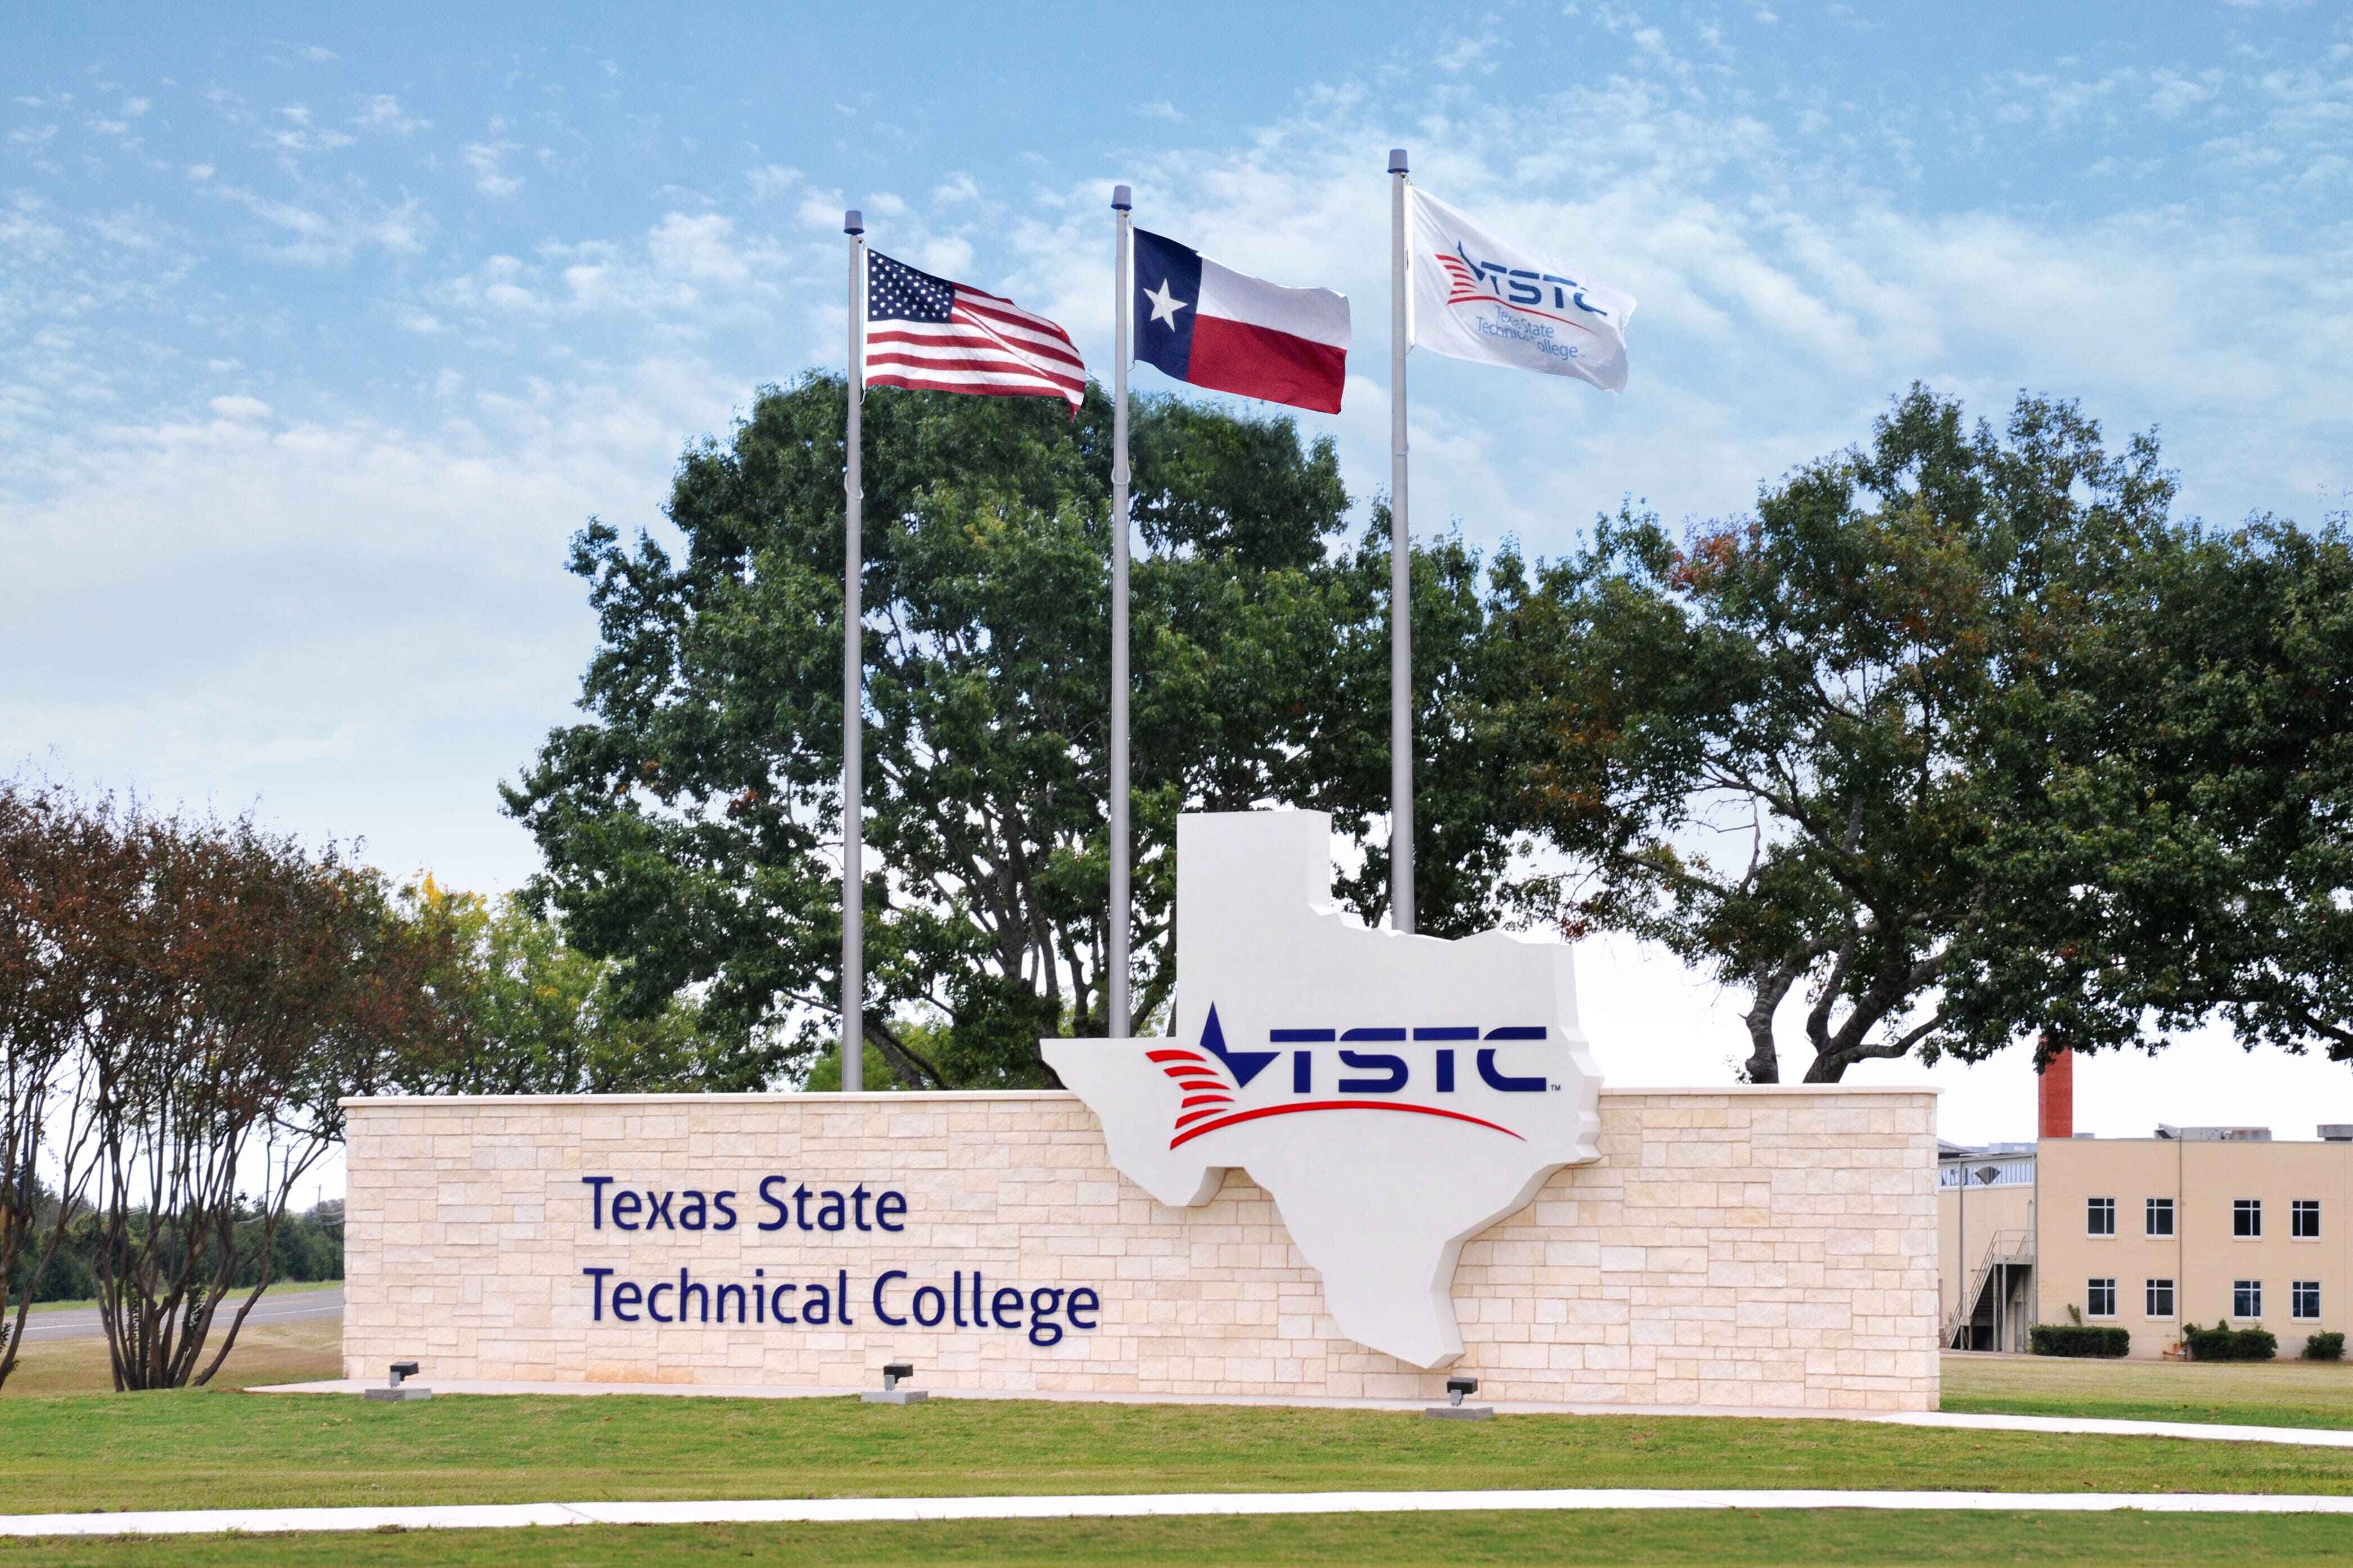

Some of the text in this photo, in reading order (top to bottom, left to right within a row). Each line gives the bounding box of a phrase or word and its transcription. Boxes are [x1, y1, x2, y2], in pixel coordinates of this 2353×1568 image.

[1481, 261, 1608, 316] TSTC
[1520, 318, 1554, 339] State
[1269, 1026, 1547, 1093] TSTC
[583, 1175, 907, 1232] Texas State
[583, 1268, 1099, 1347] Technical College
